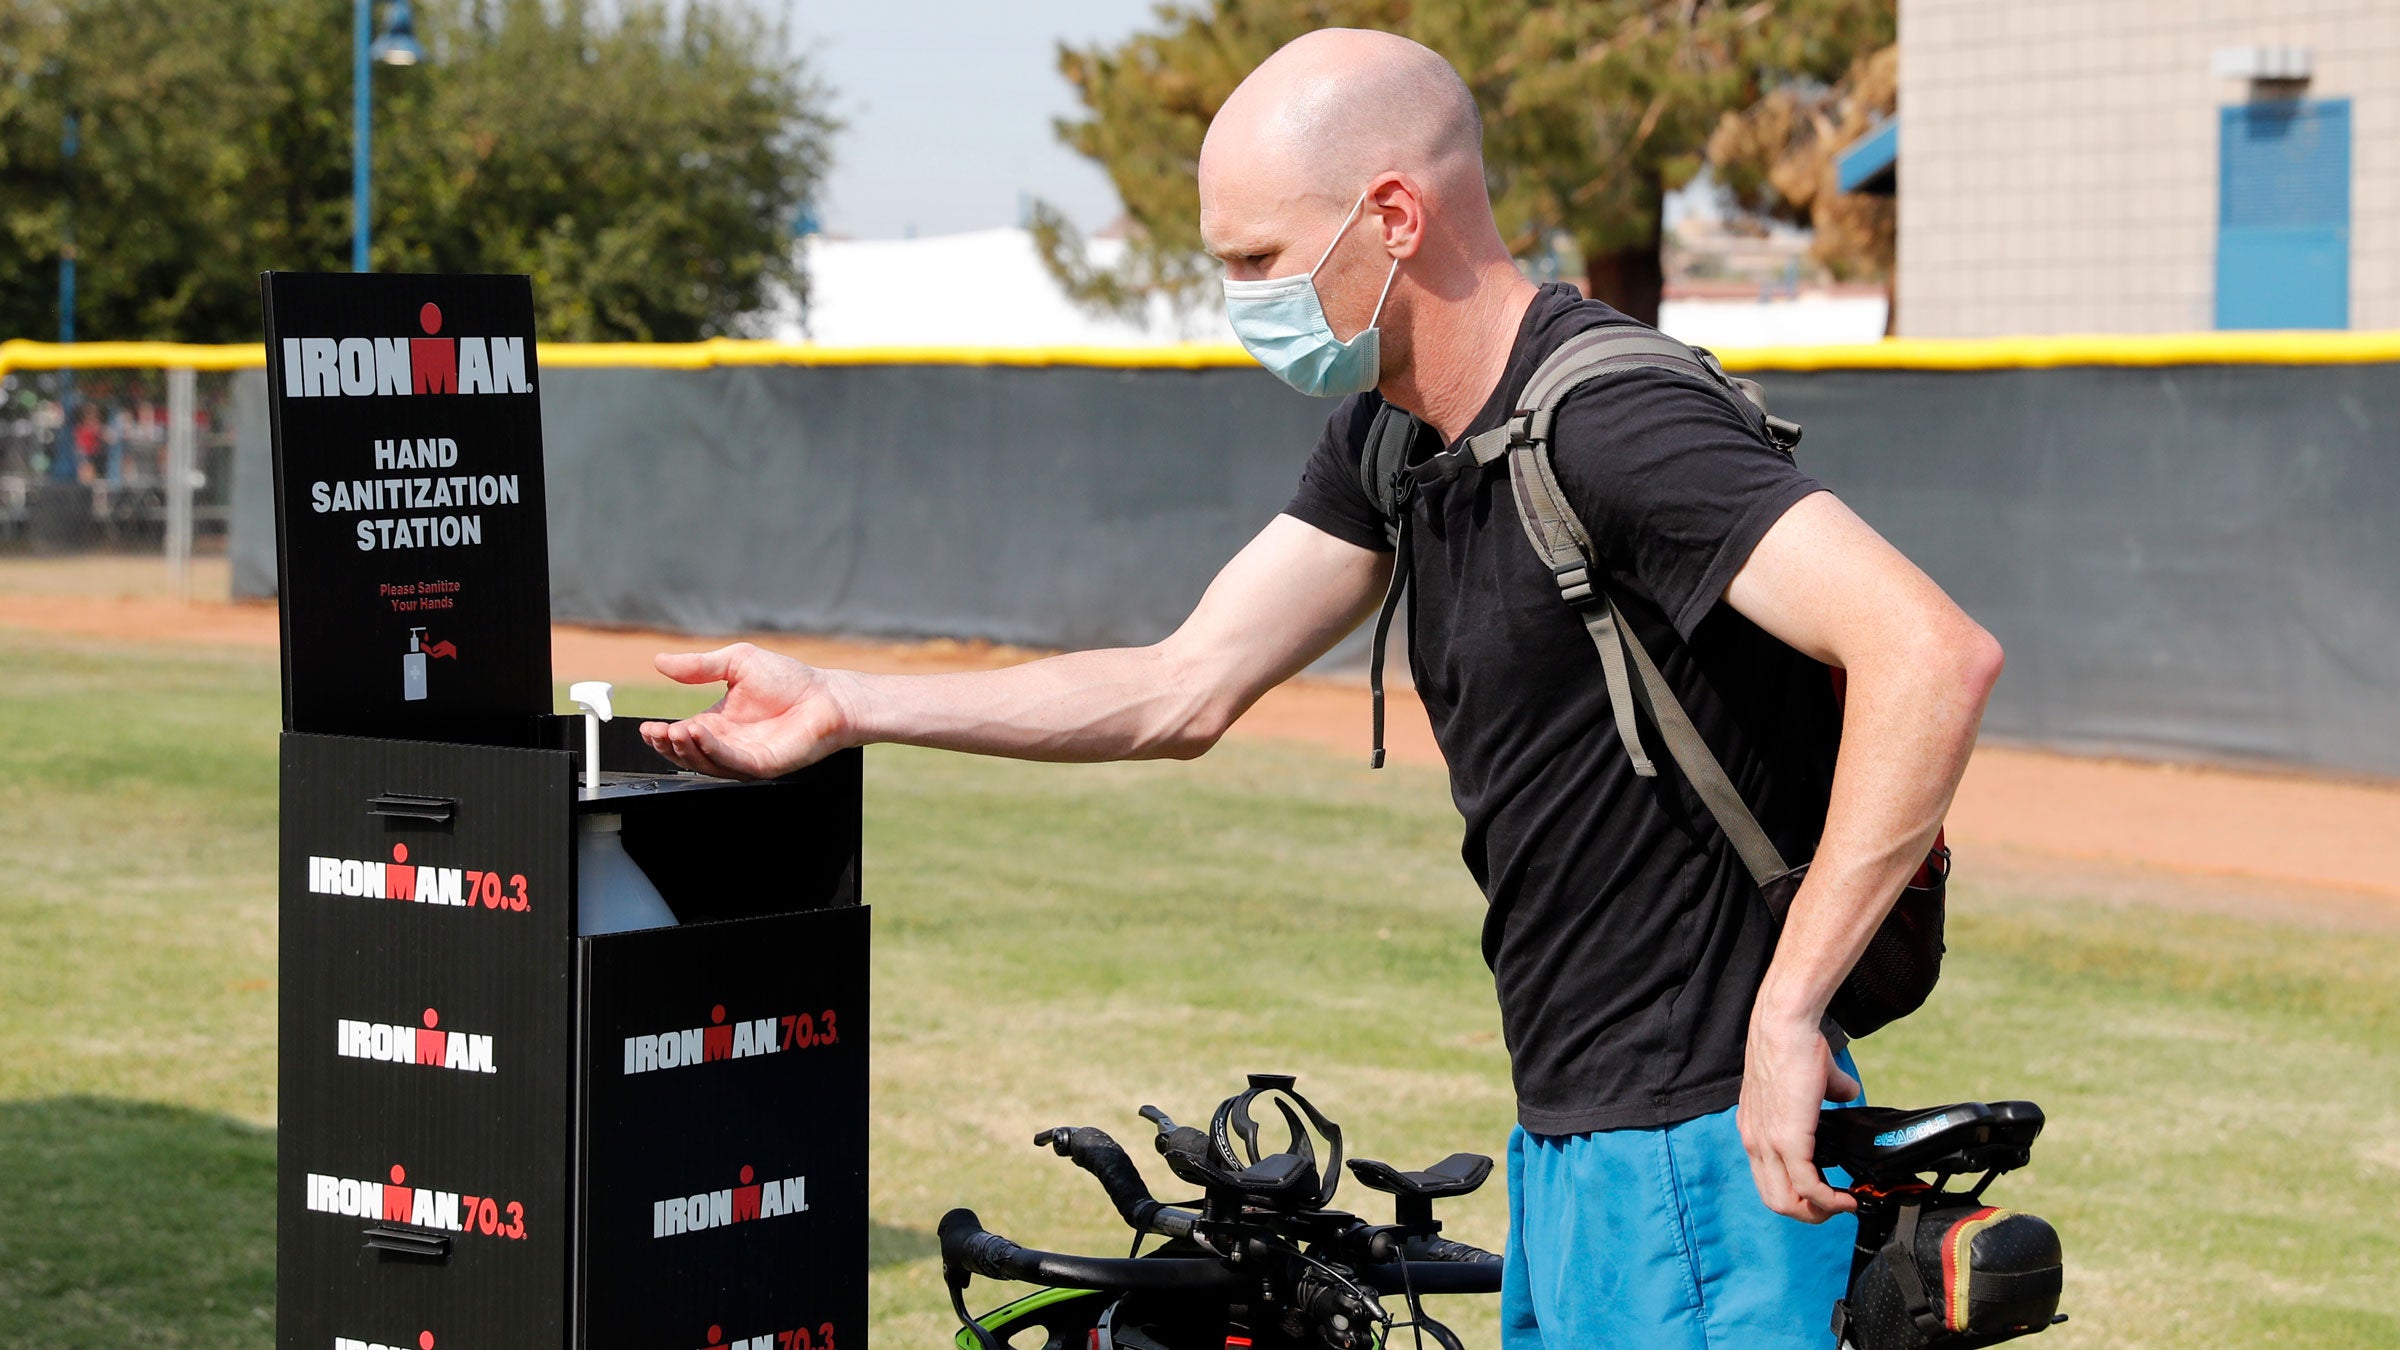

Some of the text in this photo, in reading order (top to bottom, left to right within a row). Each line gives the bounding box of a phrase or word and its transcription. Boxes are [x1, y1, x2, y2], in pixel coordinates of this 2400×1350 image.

[282, 302, 527, 398] IRONMAN
[374, 437, 458, 470] HAND
[311, 474, 520, 514] SANITIZATION
[356, 514, 482, 552] STATION
[379, 579, 461, 597] Please Sanitize
[391, 596, 454, 612] Your Hands
[308, 842, 528, 912] IRONMAN 70.3
[337, 1007, 494, 1074] IRONMAN
[623, 1004, 838, 1076] IRONMAN 70.3
[306, 1163, 524, 1240] IRONMAN 70.3
[653, 1165, 806, 1239] IRONMAN
